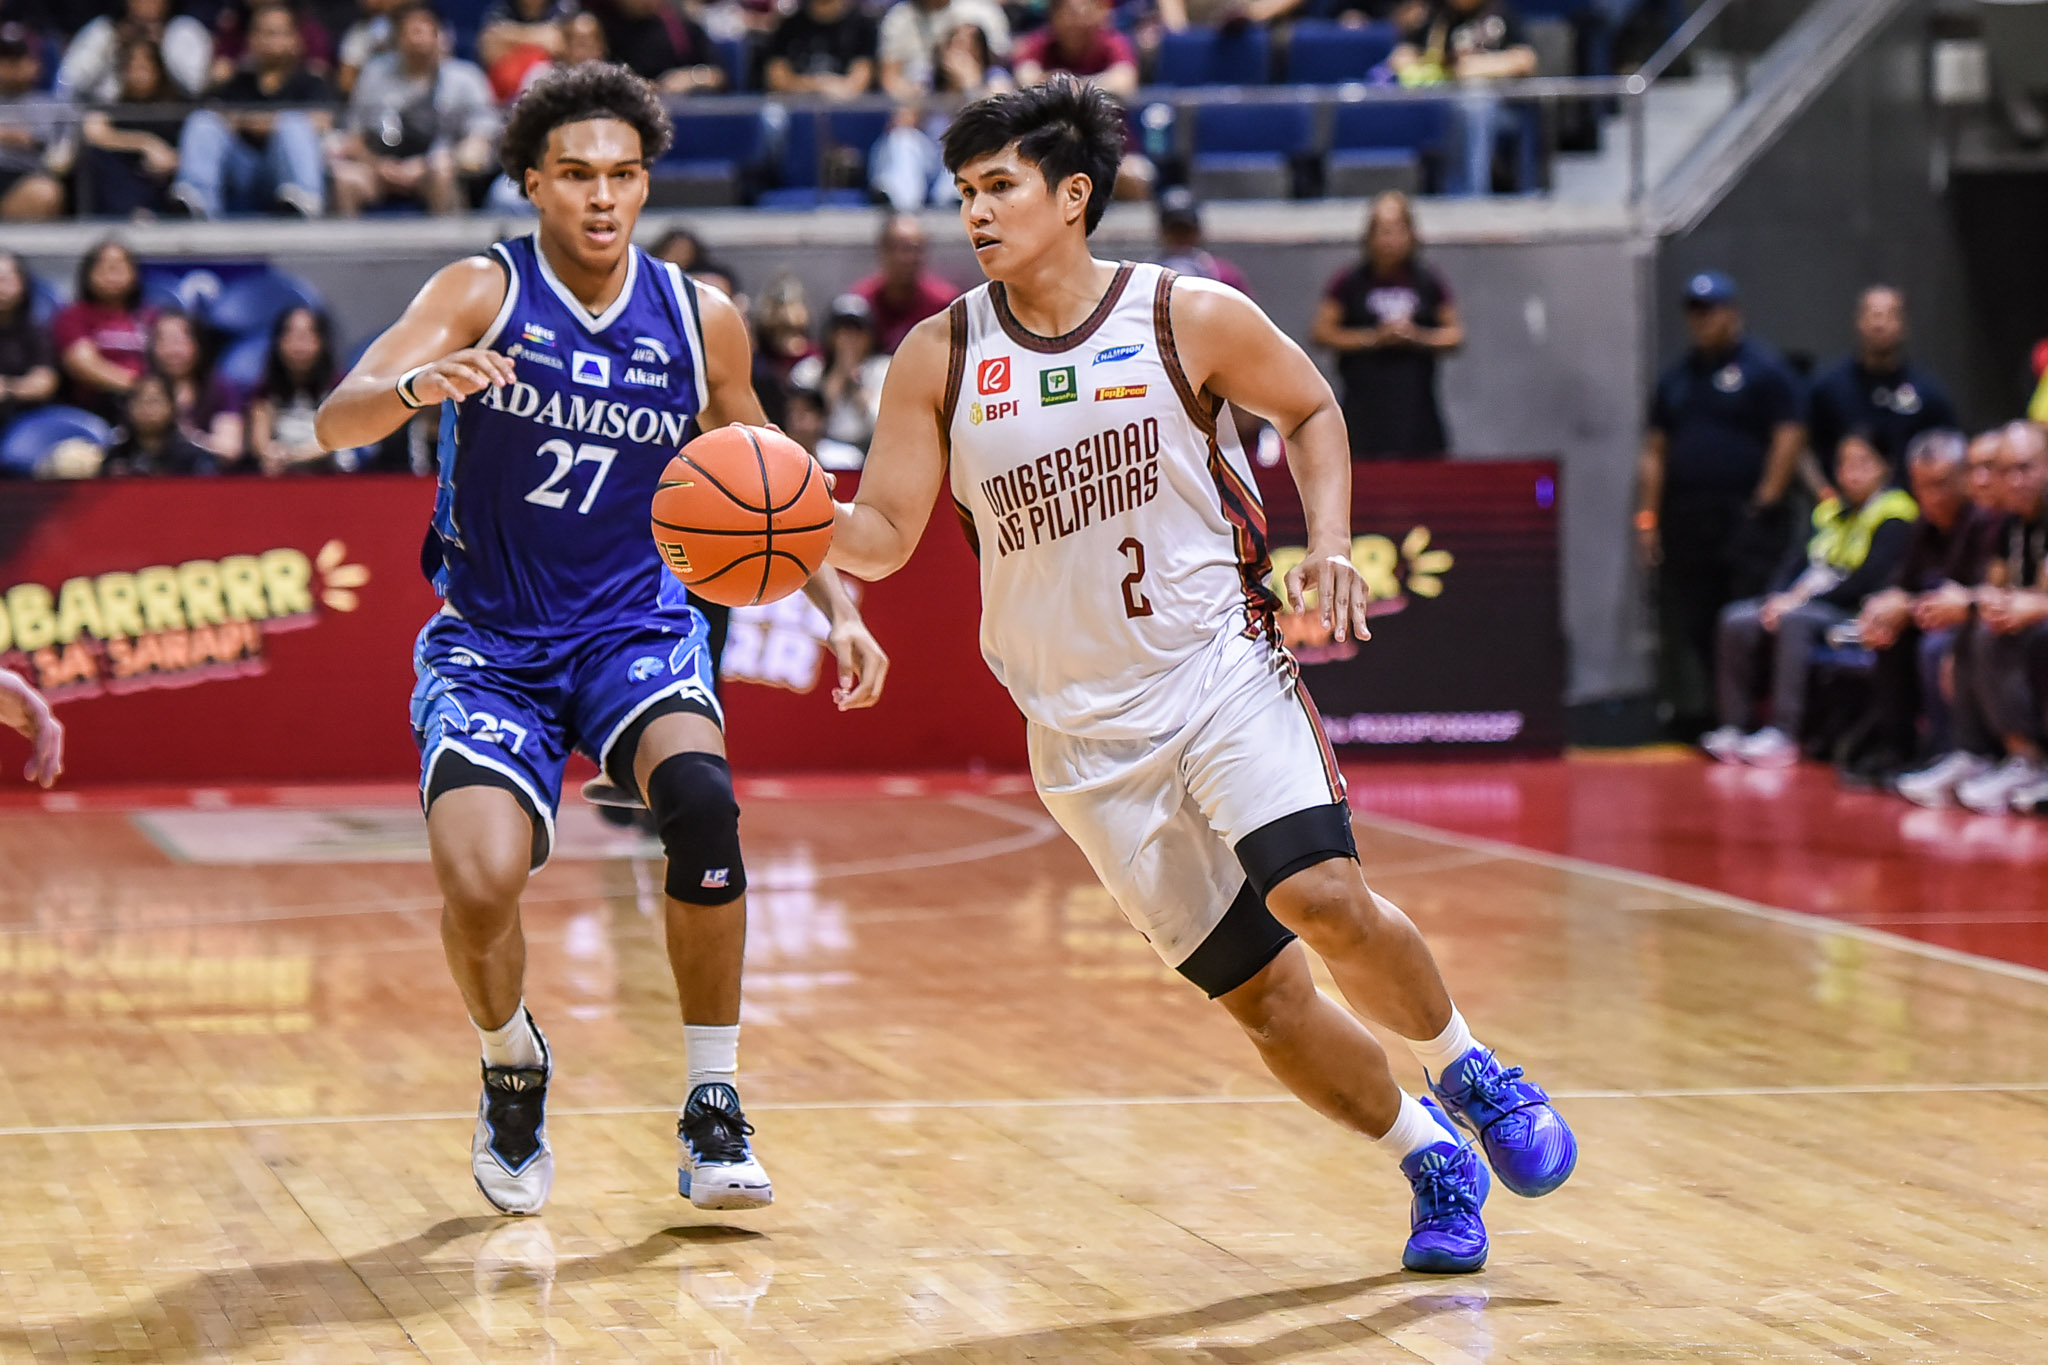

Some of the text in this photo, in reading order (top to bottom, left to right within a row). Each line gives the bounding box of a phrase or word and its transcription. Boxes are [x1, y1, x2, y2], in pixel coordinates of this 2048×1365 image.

[624, 366, 669, 390] Akari
[1095, 345, 1142, 363] CHAMPION
[479, 380, 689, 449] ADAMSON
[986, 400, 1019, 421] BPI
[524, 438, 618, 515] 27
[980, 417, 1159, 518] UNIBERSIDAD
[997, 460, 1158, 558] NG PILIPINAS
[1117, 537, 1154, 619] 2
[469, 711, 528, 755] 27
[703, 868, 727, 883] LP
